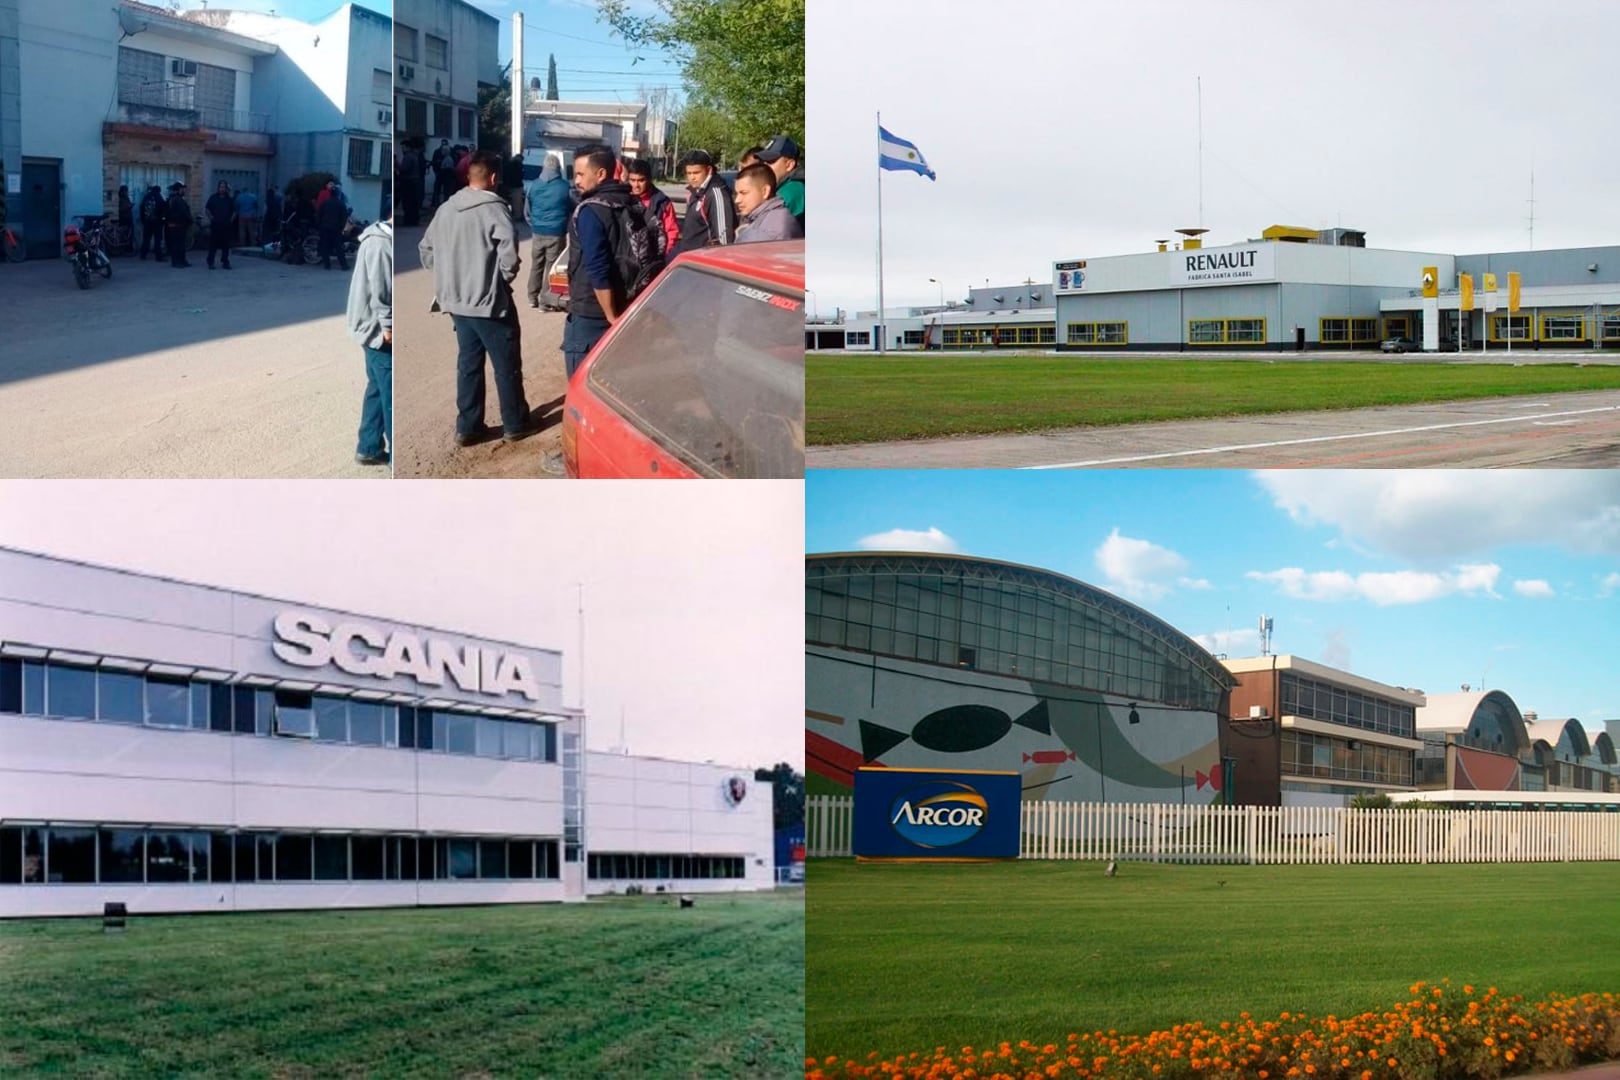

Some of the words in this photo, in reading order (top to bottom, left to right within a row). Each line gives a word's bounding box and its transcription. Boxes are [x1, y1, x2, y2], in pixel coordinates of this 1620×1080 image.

[1186, 250, 1257, 271] RENAULT
[273, 611, 539, 701] SCANIA
[892, 801, 984, 826] ARCOR
